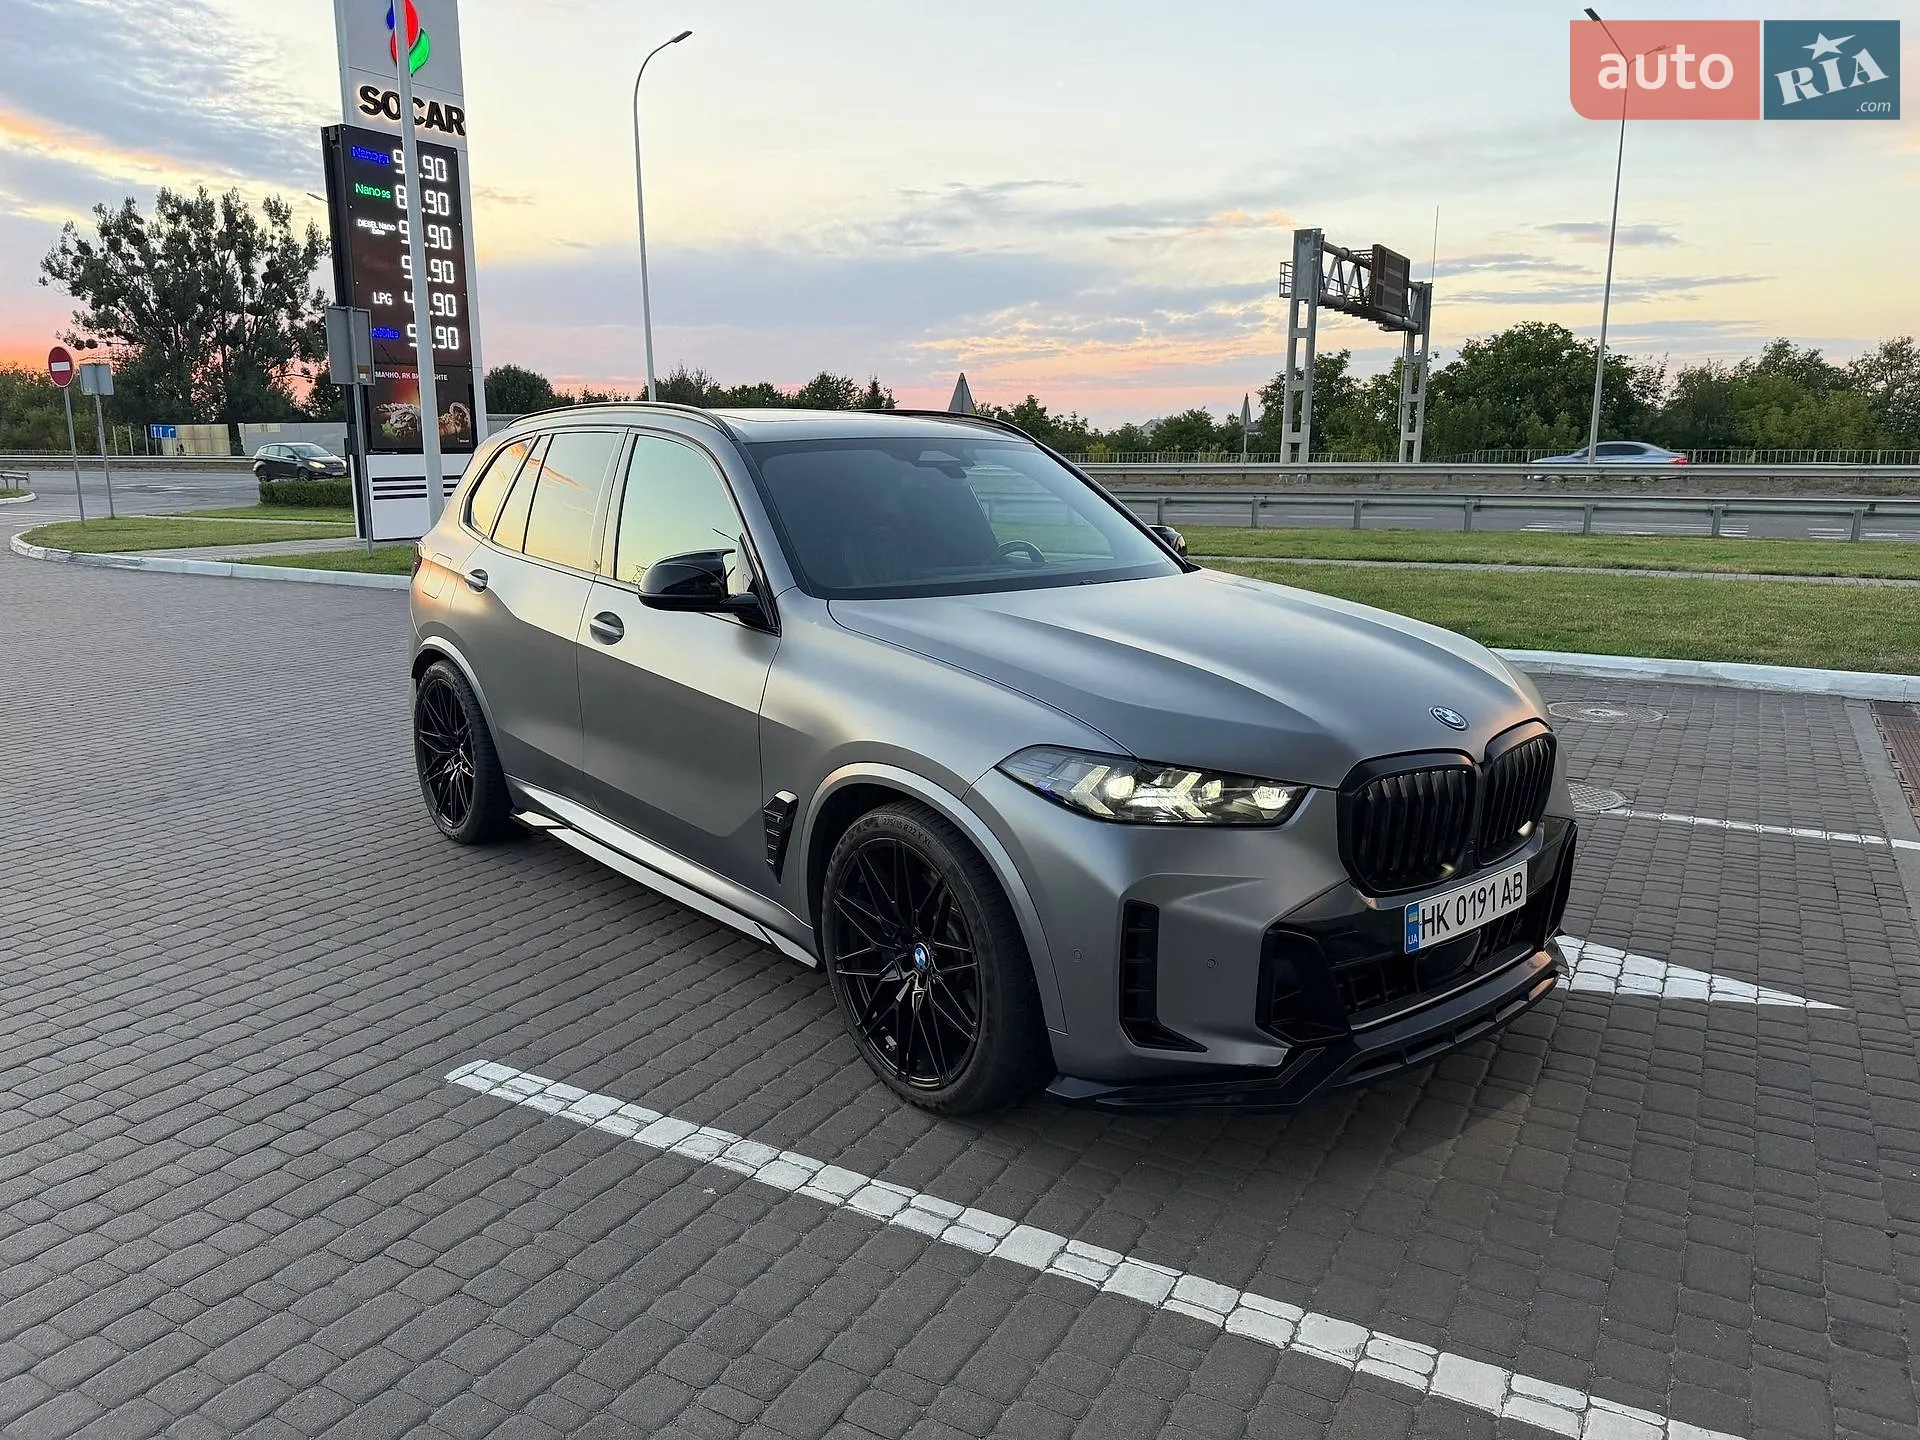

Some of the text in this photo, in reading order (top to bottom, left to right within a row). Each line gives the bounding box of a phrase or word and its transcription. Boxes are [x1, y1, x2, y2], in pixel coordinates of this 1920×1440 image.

[373, 291, 393, 305] LPG
[1421, 871, 1523, 940] HK 0191 AB
[1408, 933, 1418, 945] UA
